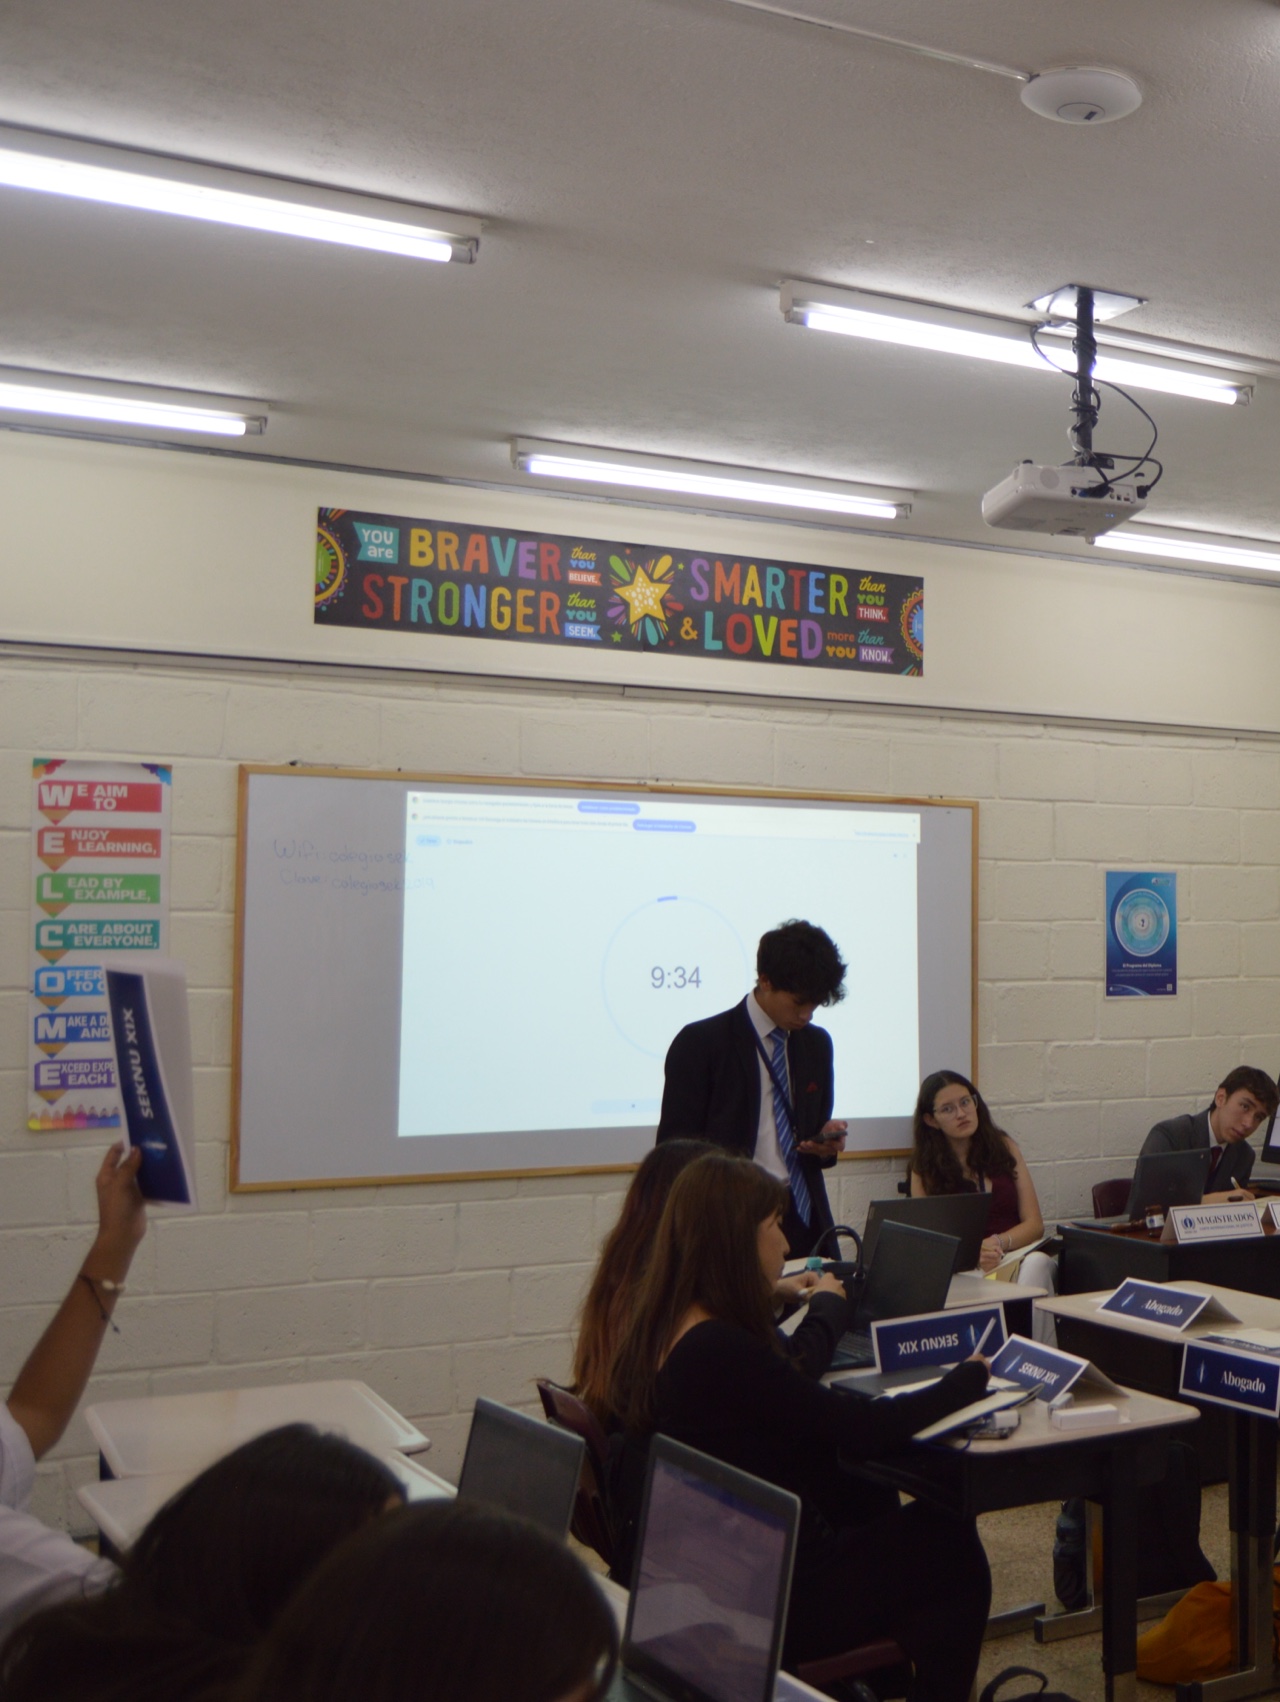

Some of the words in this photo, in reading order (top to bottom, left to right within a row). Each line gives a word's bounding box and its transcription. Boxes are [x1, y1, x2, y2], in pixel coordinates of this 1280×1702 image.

[362, 528, 393, 545] YOU
[368, 544, 393, 559] are
[410, 528, 562, 581] BRAVER
[571, 545, 597, 561] than
[570, 558, 595, 570] YOU
[569, 572, 598, 584] BELIEVE.
[859, 576, 886, 593] than
[690, 558, 849, 617] SMARTER
[362, 573, 561, 635] STRONGER
[567, 592, 596, 608] than
[857, 593, 885, 606] YOU
[566, 609, 597, 622] YOU
[859, 607, 886, 620] THINK.
[568, 625, 596, 638] SEEM.
[704, 610, 823, 659] LOVED
[828, 631, 855, 643] more
[858, 629, 885, 645] than
[826, 646, 857, 659] YOU
[861, 648, 891, 663] KNOW.
[93, 785, 128, 797] AIM
[93, 798, 117, 810] TO
[78, 842, 157, 855] LEARNING,
[103, 878, 123, 888] BY
[102, 924, 153, 935] ABOUT
[651, 966, 701, 989] 9:34
[1197, 1213, 1254, 1224] MAGISTRADOS
[1142, 1299, 1183, 1317] Abogado
[898, 1341, 918, 1355] XIX
[921, 1333, 959, 1351] SEKNU
[1018, 1362, 1046, 1380] SEKNU
[1221, 1370, 1266, 1394] Abogado
